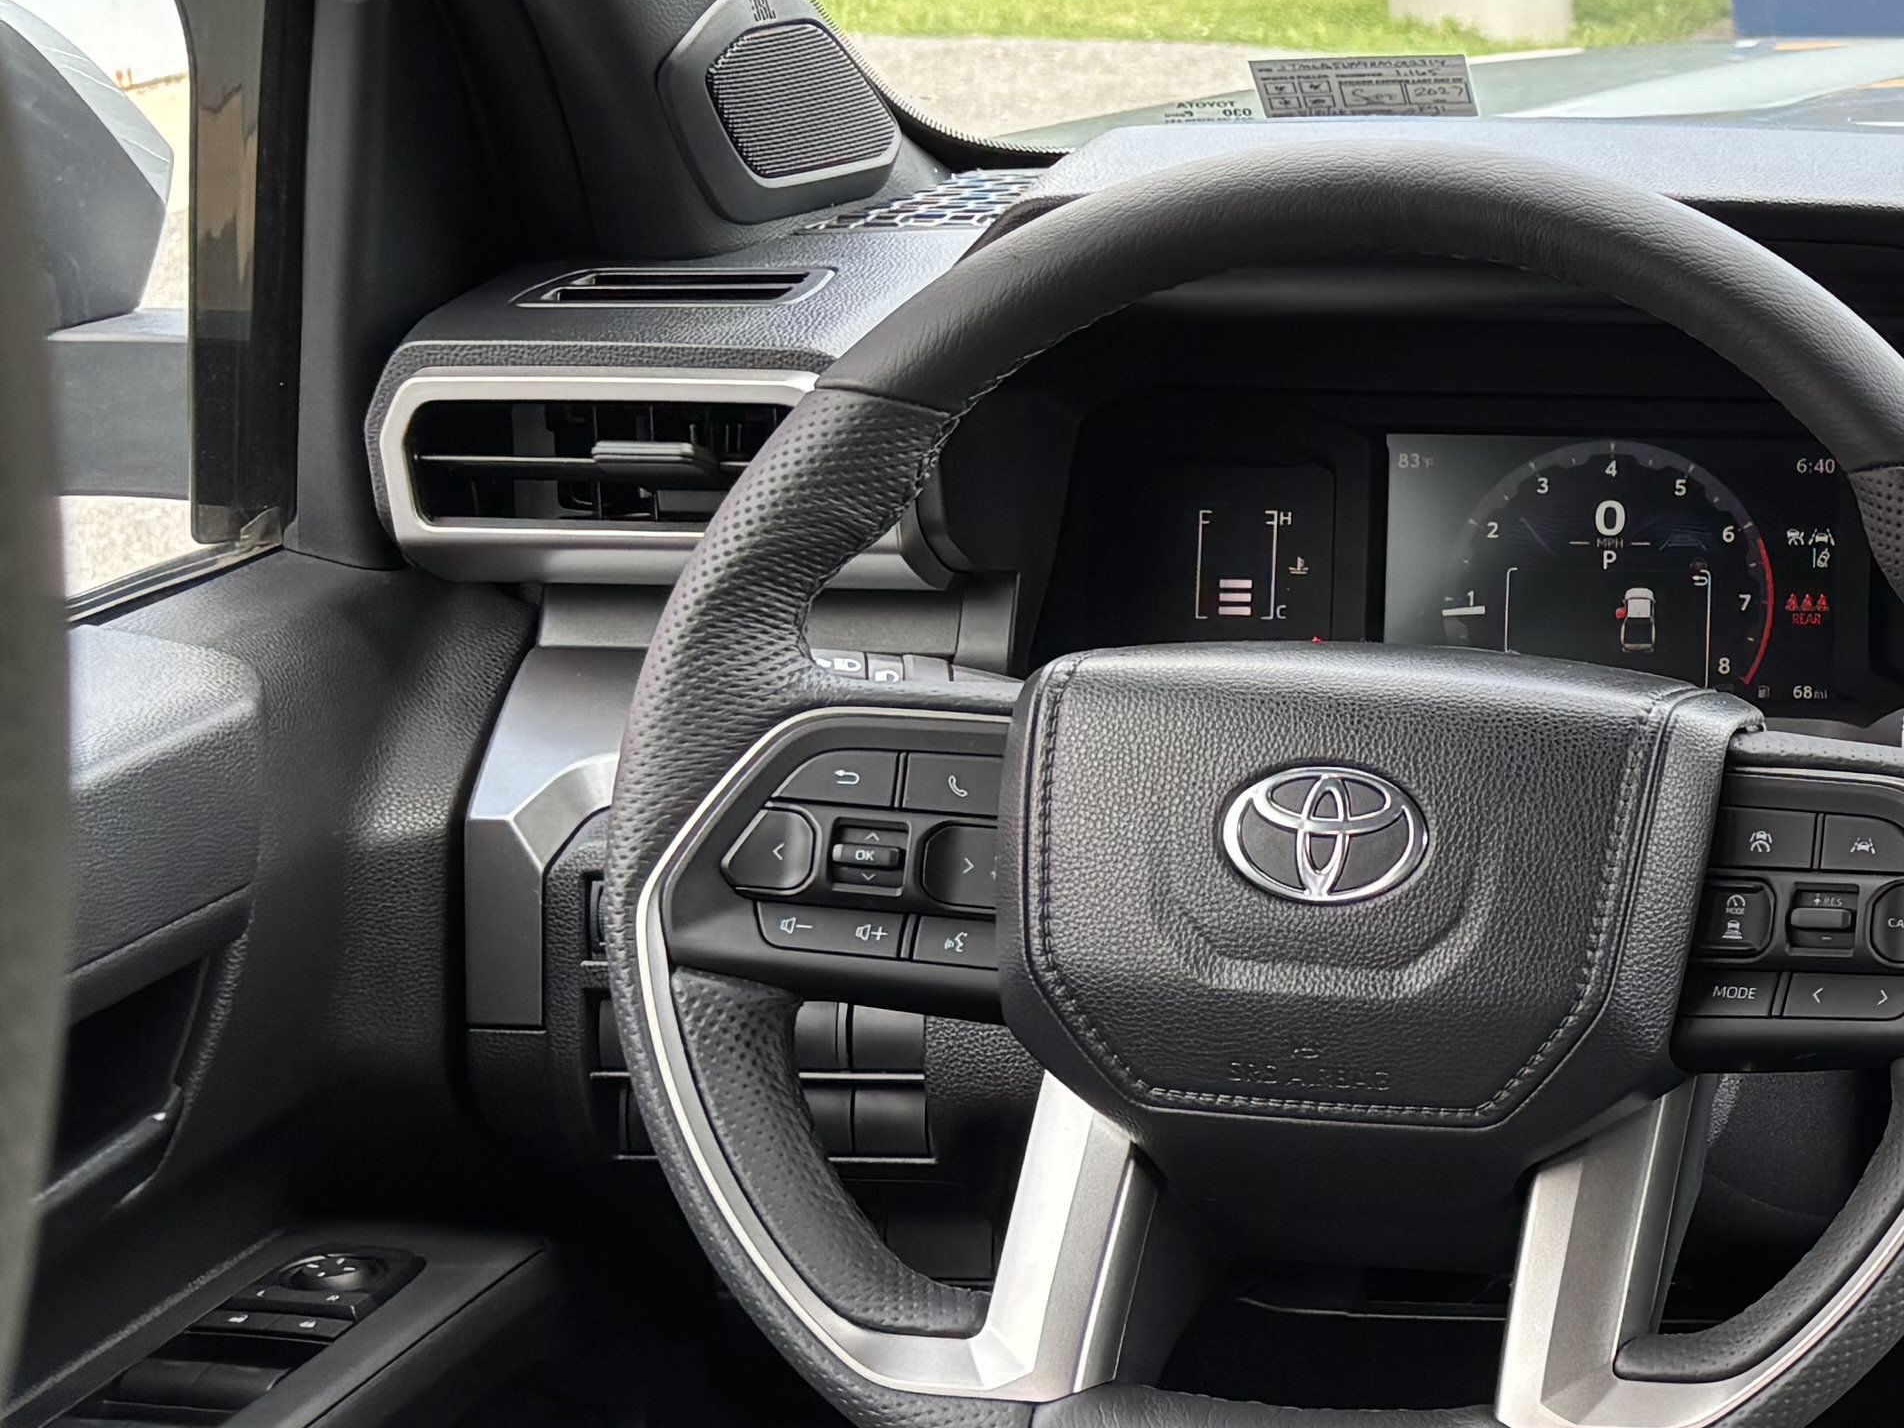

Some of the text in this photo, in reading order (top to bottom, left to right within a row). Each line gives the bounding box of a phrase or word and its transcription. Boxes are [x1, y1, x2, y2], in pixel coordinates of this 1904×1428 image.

[1605, 459, 1618, 478] 4
[1796, 458, 1836, 474] 6:40
[1536, 477, 1549, 494] 3
[1674, 479, 1687, 496] 5
[1279, 511, 1292, 526] H
[1594, 499, 1627, 537] 0
[1486, 521, 1500, 539] 2
[1721, 525, 1735, 543] 6
[1596, 538, 1624, 549] MPH
[1602, 550, 1618, 570] P
[1466, 590, 1475, 607] 1
[1738, 593, 1752, 612] 7
[1276, 604, 1287, 619] C
[1791, 613, 1822, 626] REAR
[1717, 657, 1731, 675] 8
[855, 849, 875, 861] OK
[1712, 985, 1757, 1000] MODE
